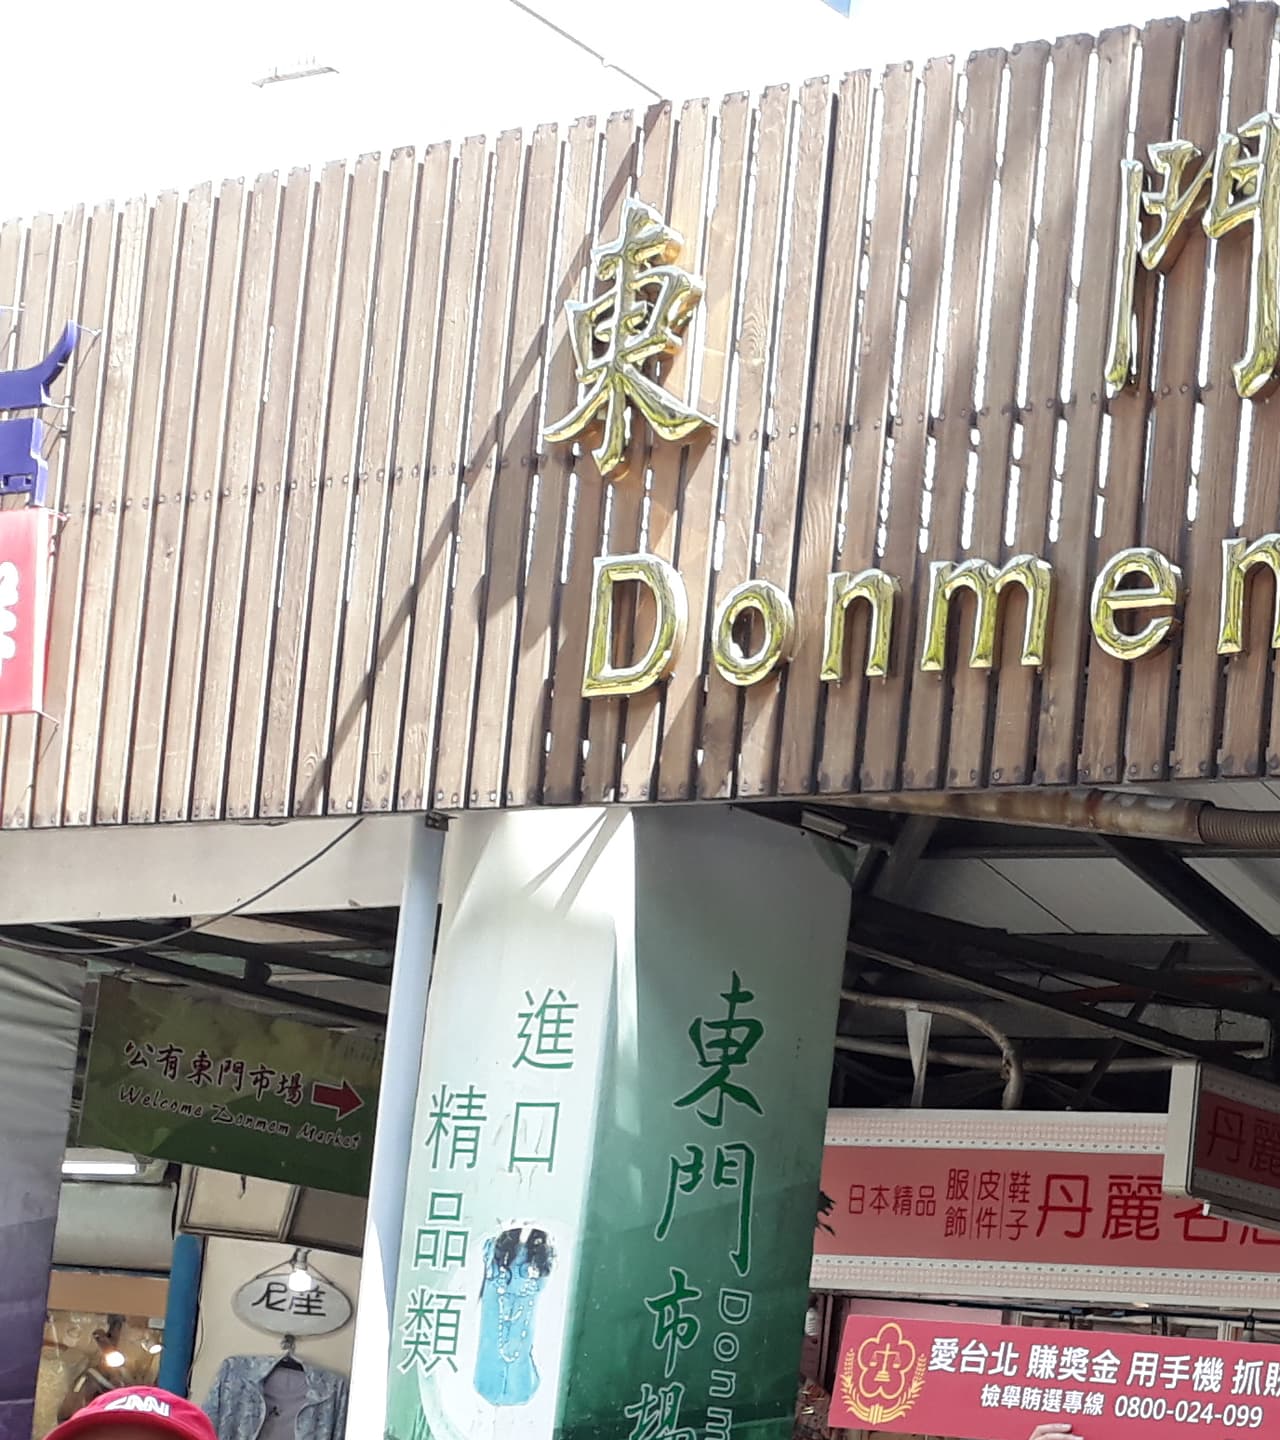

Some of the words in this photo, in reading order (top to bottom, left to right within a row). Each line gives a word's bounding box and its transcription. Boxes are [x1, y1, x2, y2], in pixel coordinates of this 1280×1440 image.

[124, 1041, 303, 1107] 公有東門市場
[507, 987, 579, 1174] 進口
[119, 1084, 202, 1117] Welcome
[297, 1125, 361, 1151] Market
[398, 1082, 488, 1375] 精品類
[847, 1183, 937, 1218] 日本精品
[929, 1337, 1019, 1376] 愛台北
[1028, 1343, 1120, 1385] 賺獎金
[1126, 1353, 1223, 1395] 用手機
[981, 1384, 1104, 1417] 檢舉賄選專線
[1114, 1395, 1263, 1429] 0800-024-099
